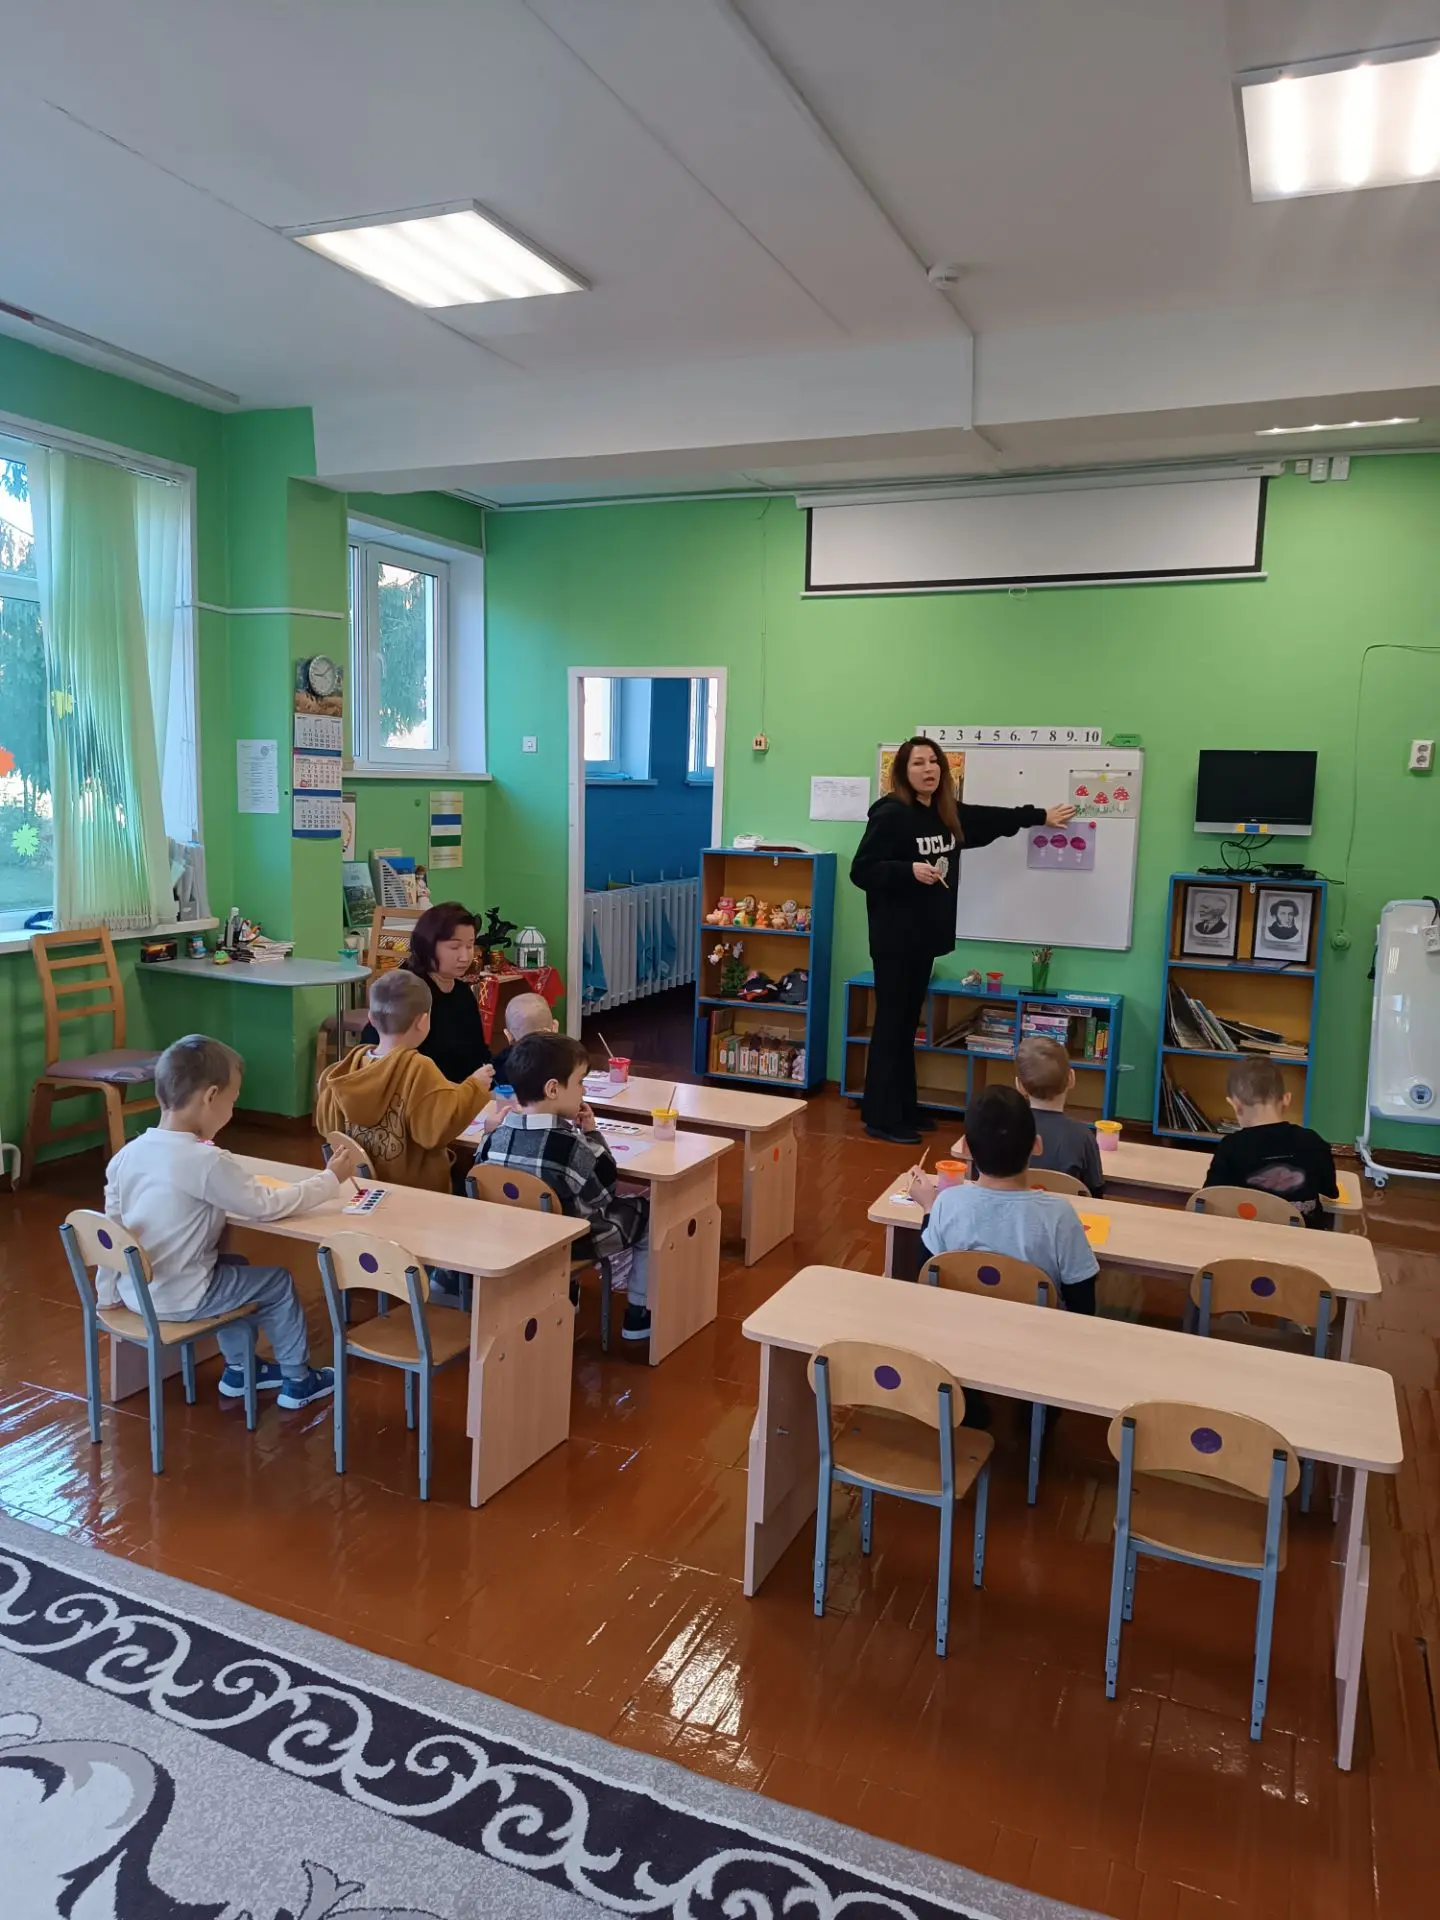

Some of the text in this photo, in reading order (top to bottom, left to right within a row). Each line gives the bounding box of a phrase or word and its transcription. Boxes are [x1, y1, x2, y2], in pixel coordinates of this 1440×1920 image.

[922, 729, 926, 738] 1
[939, 729, 946, 740] 2
[956, 729, 964, 741] 3
[974, 730, 982, 741] 4
[993, 730, 1001, 741] 5
[1030, 730, 1038, 741] 7
[1049, 730, 1057, 742] 8
[1084, 731, 1099, 743] 10
